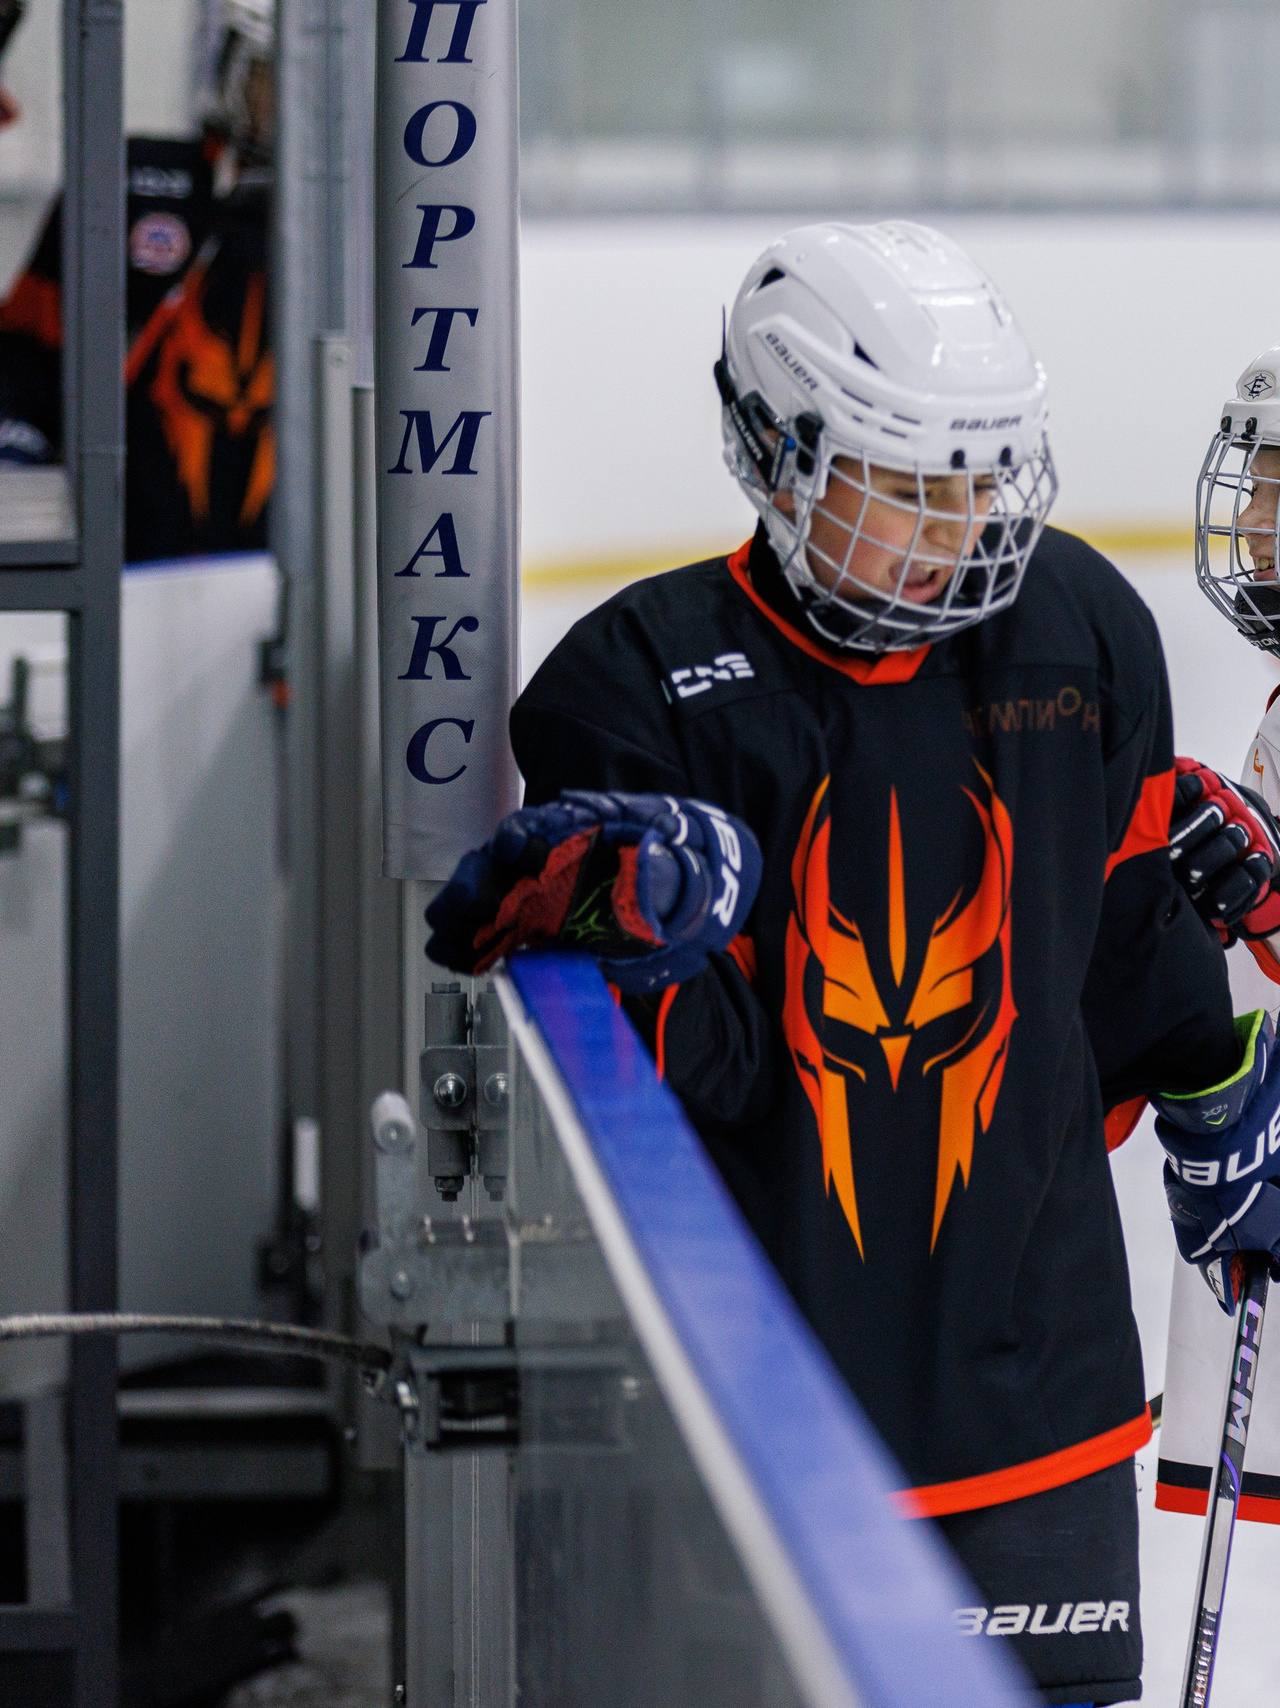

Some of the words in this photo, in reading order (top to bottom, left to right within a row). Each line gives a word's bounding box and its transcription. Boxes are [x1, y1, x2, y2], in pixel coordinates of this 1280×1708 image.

[765, 332, 819, 391] BAUER
[950, 414, 1022, 431] BAUER
[962, 686, 1101, 736] МПИОН
[1225, 1298, 1264, 1448] CCM
[951, 1600, 1130, 1637] BAUER
